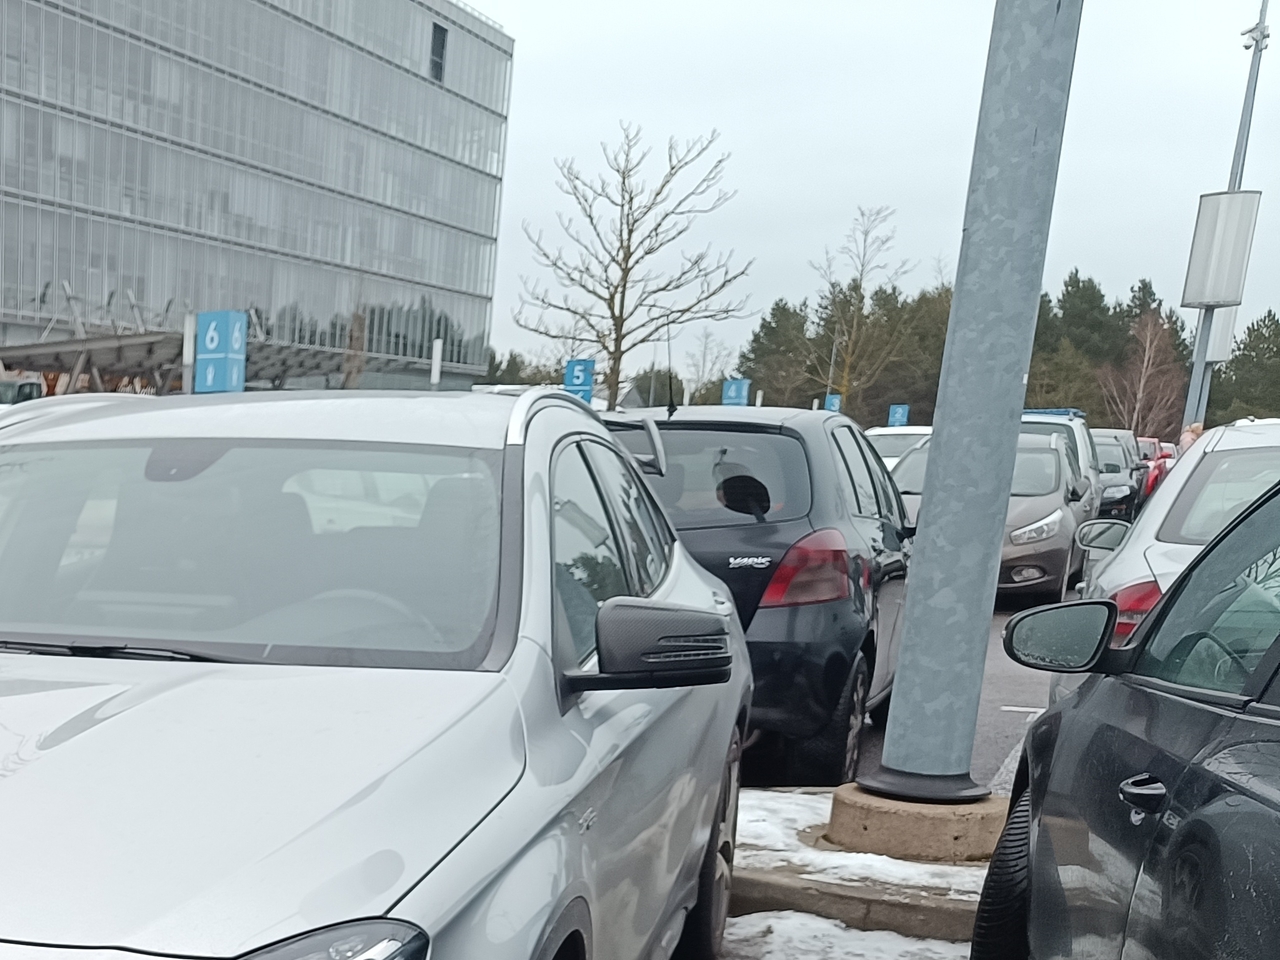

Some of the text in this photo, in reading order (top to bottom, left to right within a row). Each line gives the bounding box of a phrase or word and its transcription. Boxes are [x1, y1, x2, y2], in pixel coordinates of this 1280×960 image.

[205, 320, 219, 350] 6
[232, 321, 242, 351] 6
[572, 365, 585, 385] 5
[727, 383, 736, 398] 4
